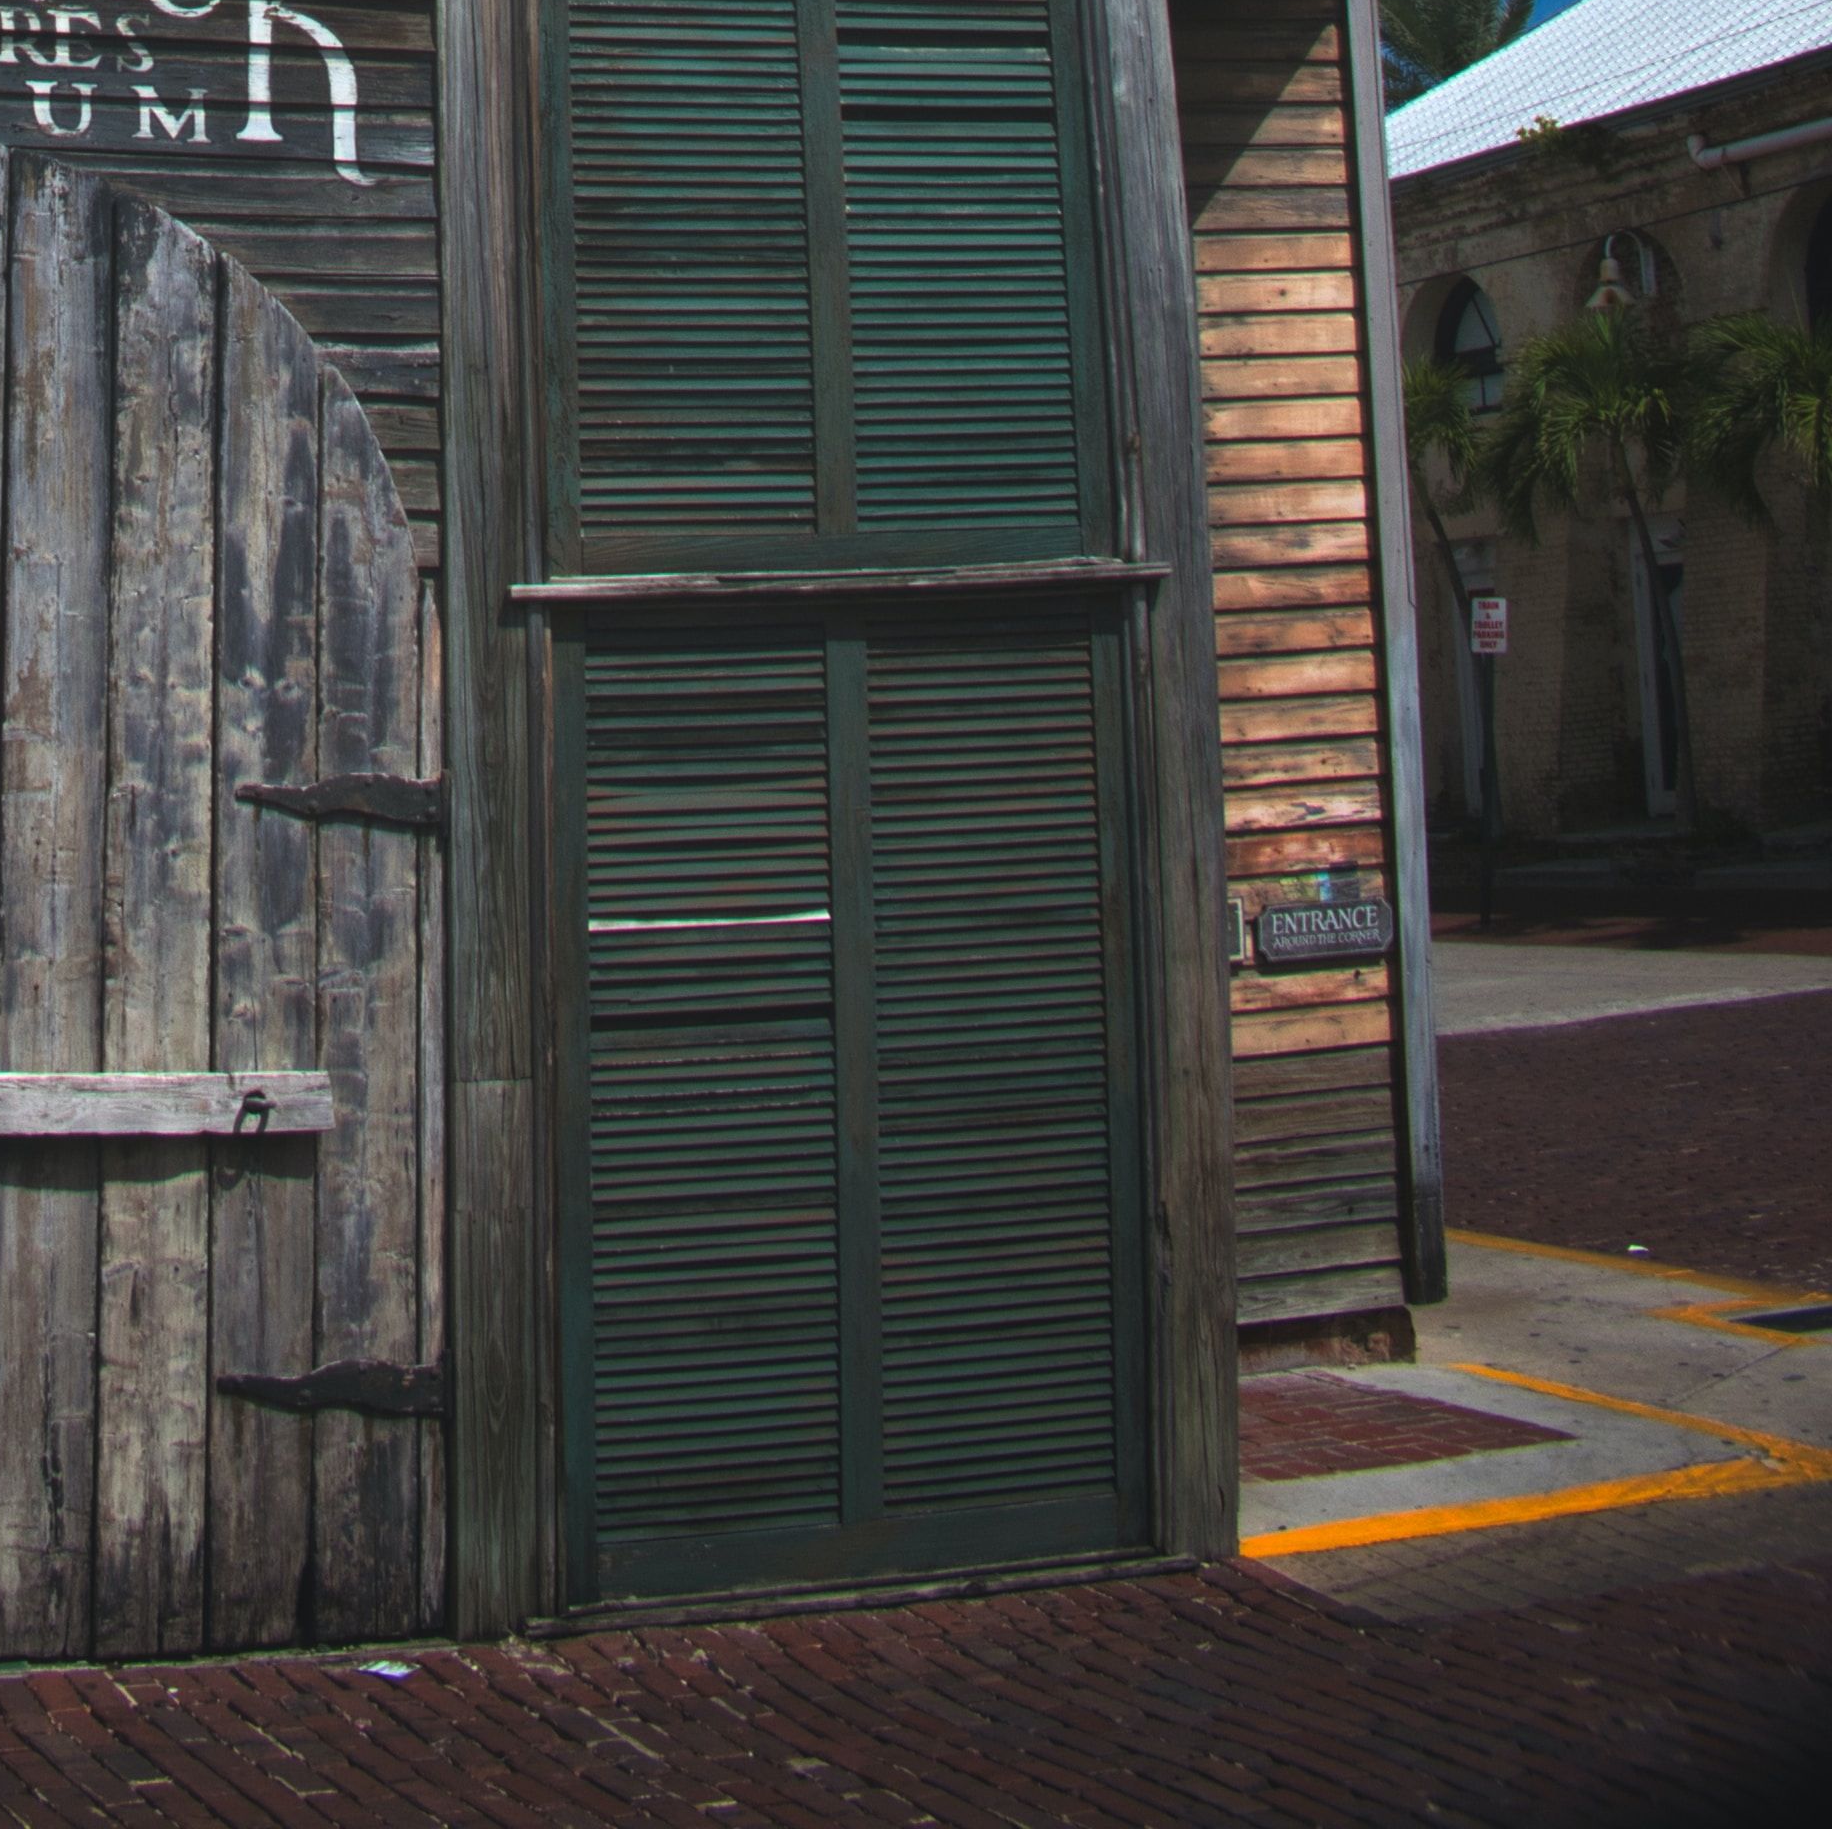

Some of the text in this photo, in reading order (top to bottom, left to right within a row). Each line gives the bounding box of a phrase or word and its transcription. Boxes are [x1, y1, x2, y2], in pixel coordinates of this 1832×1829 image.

[1271, 905, 1379, 934] ENTRANCE
[1272, 928, 1382, 950] AROUND THE CORNER
